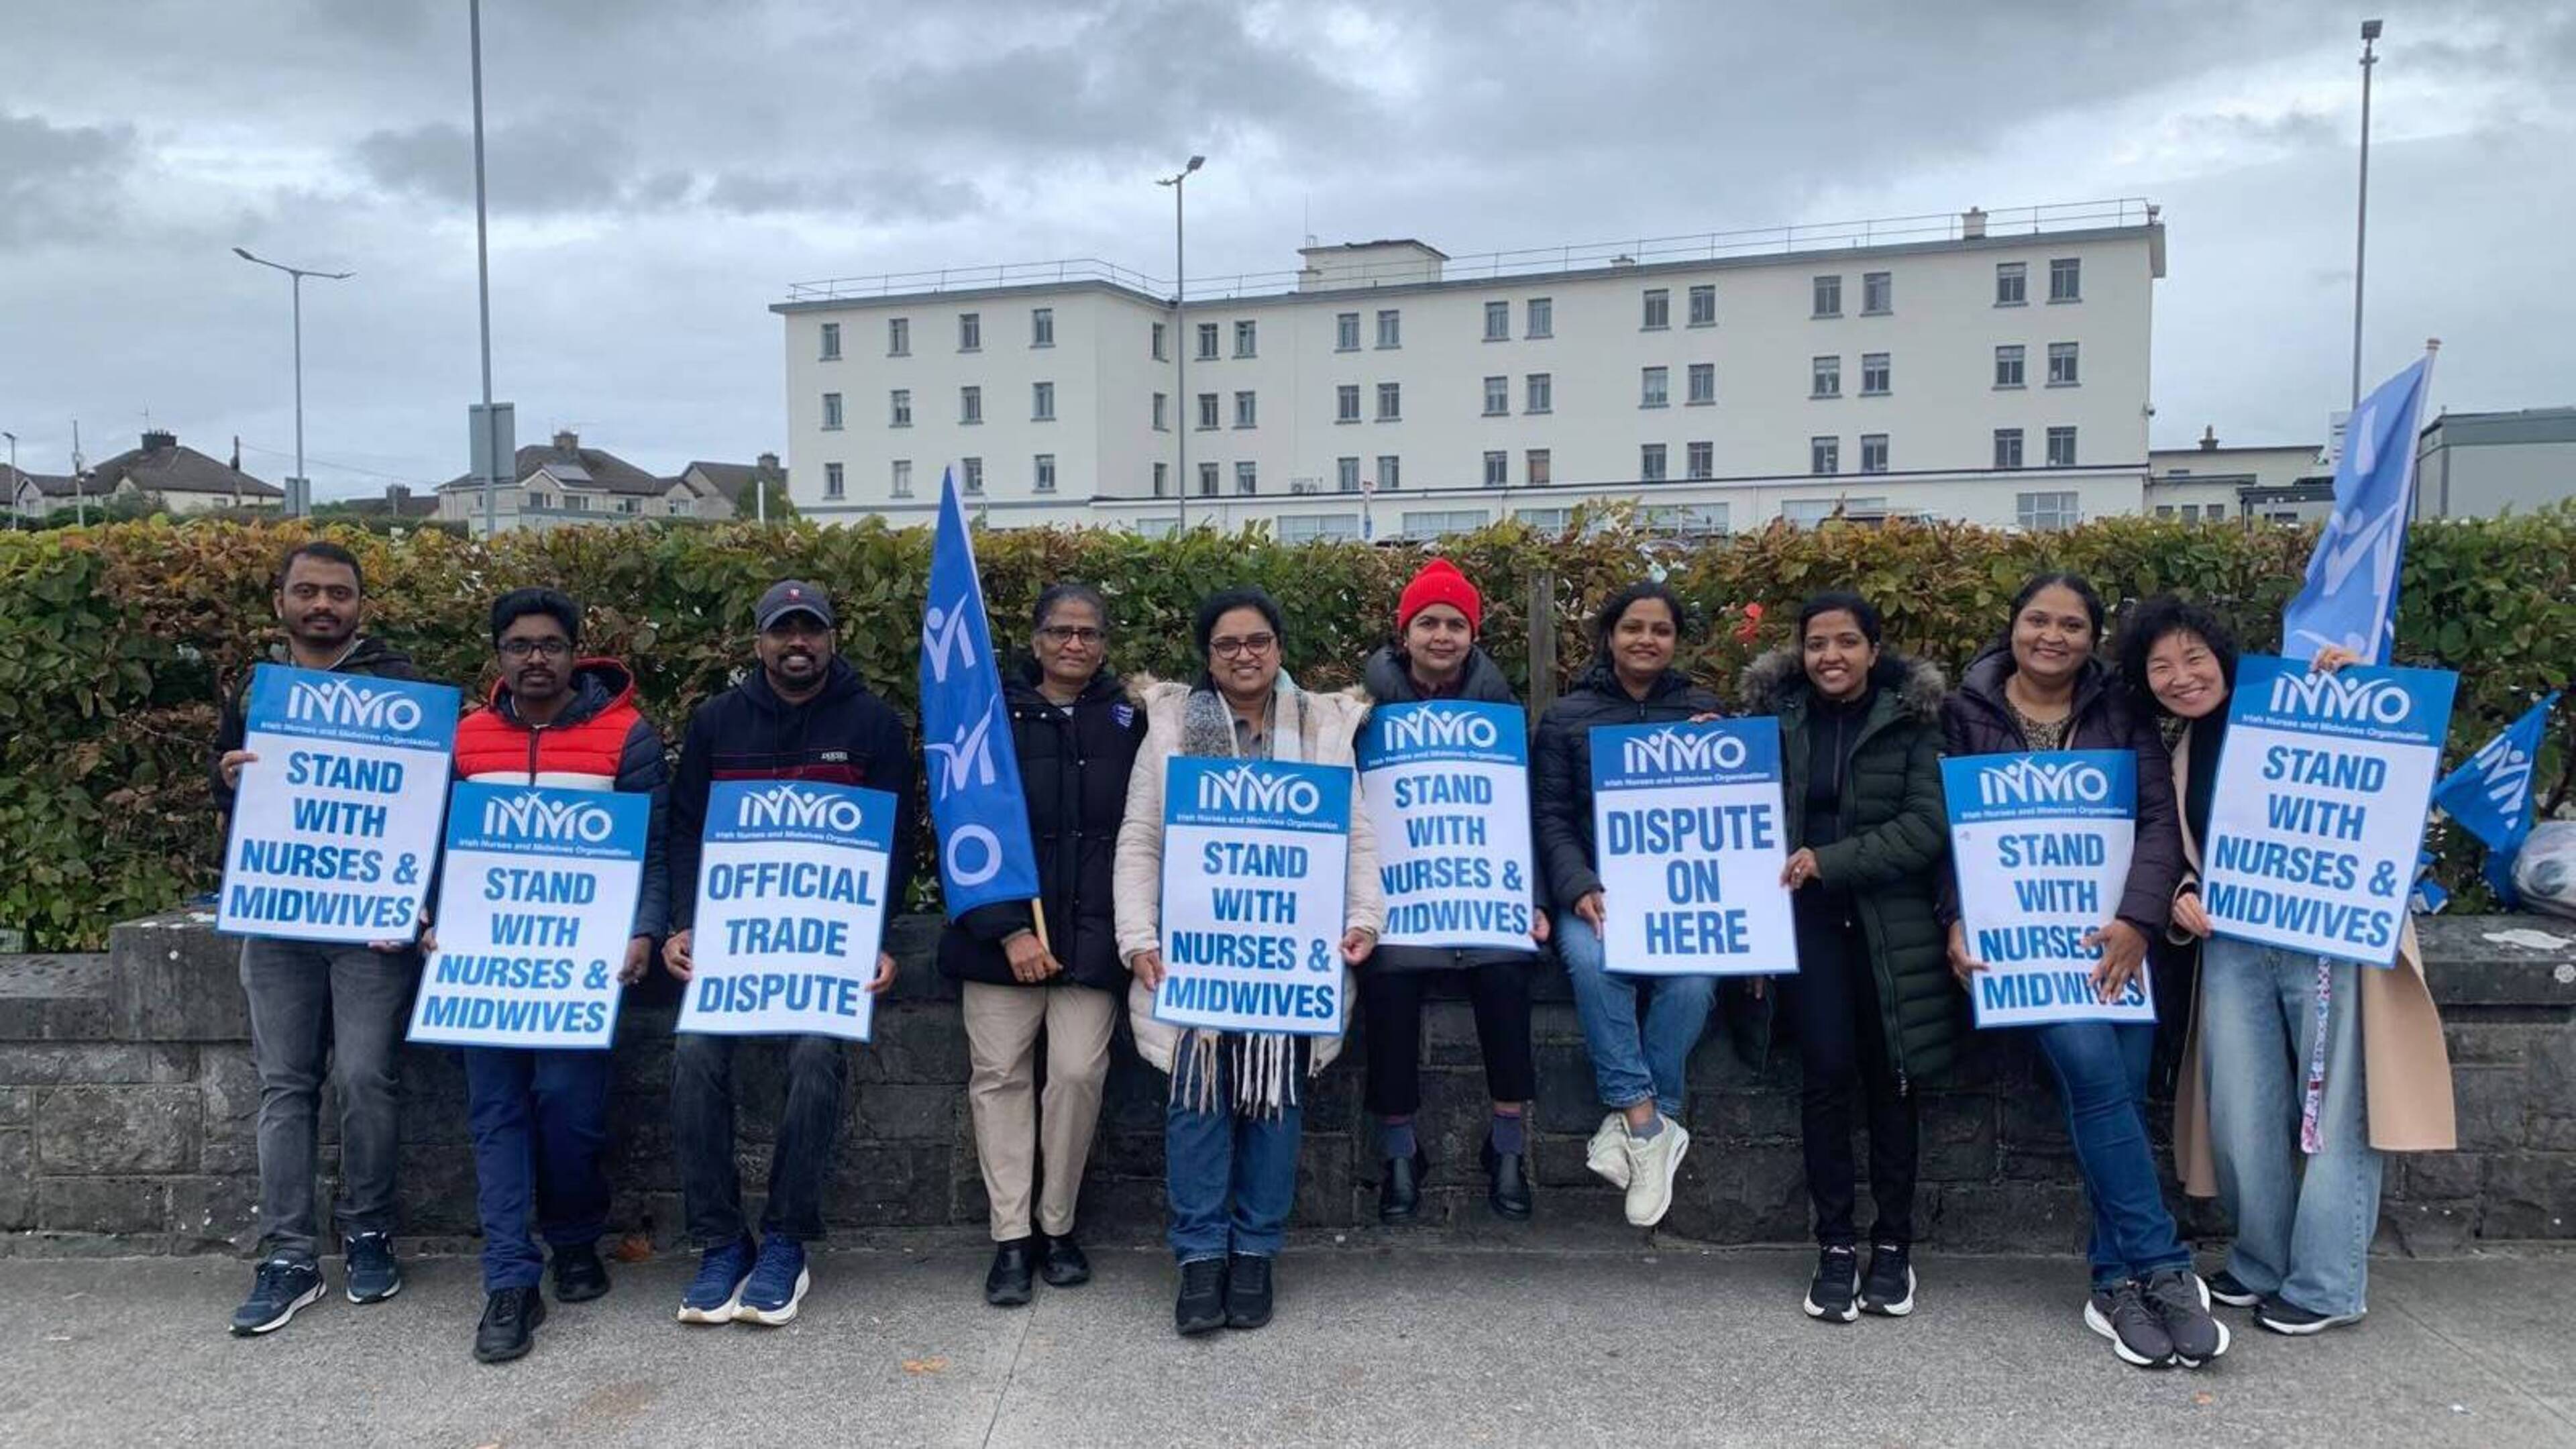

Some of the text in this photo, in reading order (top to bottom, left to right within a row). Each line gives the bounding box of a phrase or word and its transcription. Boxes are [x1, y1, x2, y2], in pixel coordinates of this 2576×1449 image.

[286, 678, 421, 731] INMO
[2269, 669, 2411, 723] INMO
[284, 724, 316, 735] Nurses
[319, 727, 336, 735] and
[339, 729, 380, 741] Midwives
[383, 735, 440, 747] Organisation
[1385, 704, 1497, 751] INMO
[2300, 720, 2318, 730] and
[1624, 726, 1746, 773] INMO
[2263, 745, 2387, 793] STAND
[286, 751, 403, 794] STAND
[1199, 763, 1320, 814] INMO
[1395, 773, 1492, 808] STAND
[1980, 755, 2108, 804] INMO
[294, 798, 386, 837] WITH
[483, 792, 611, 843] INMO
[738, 784, 862, 832] INMO
[1197, 814, 1226, 823] Nurses
[1246, 817, 1284, 825] Midwives
[1287, 818, 1338, 829] Organisation
[2268, 793, 2365, 842] WITH
[459, 839, 632, 856] Irish Nurses and Midwives Organisation
[785, 831, 824, 840] Midwives
[1406, 816, 1486, 848] WITH
[1607, 804, 1774, 855] DISPUTE
[1997, 833, 2104, 868] STAND
[239, 839, 419, 885] NURSES &
[1203, 841, 1308, 879] STAND
[1380, 857, 1523, 895] NURSES &
[2215, 835, 2397, 898] NURSES &
[484, 867, 596, 904] STAND
[707, 862, 877, 906] OFFICIAL
[1666, 859, 1720, 905] ON
[2015, 879, 2098, 913] WITH
[229, 885, 415, 928] MIDWIVES
[1212, 888, 1296, 924] WITH
[2207, 881, 2393, 948] MIDWIVES
[491, 913, 580, 947] WITH
[726, 918, 849, 957] TRADE
[1646, 909, 1750, 955] HERE
[1978, 925, 2103, 962] NURSES
[436, 955, 608, 989] NURSES &
[1171, 931, 1331, 972] NURSES &
[422, 996, 606, 1032] MIDWIVES
[696, 974, 859, 1017] DISPUTE
[1165, 977, 1334, 1019] MIDWIVES
